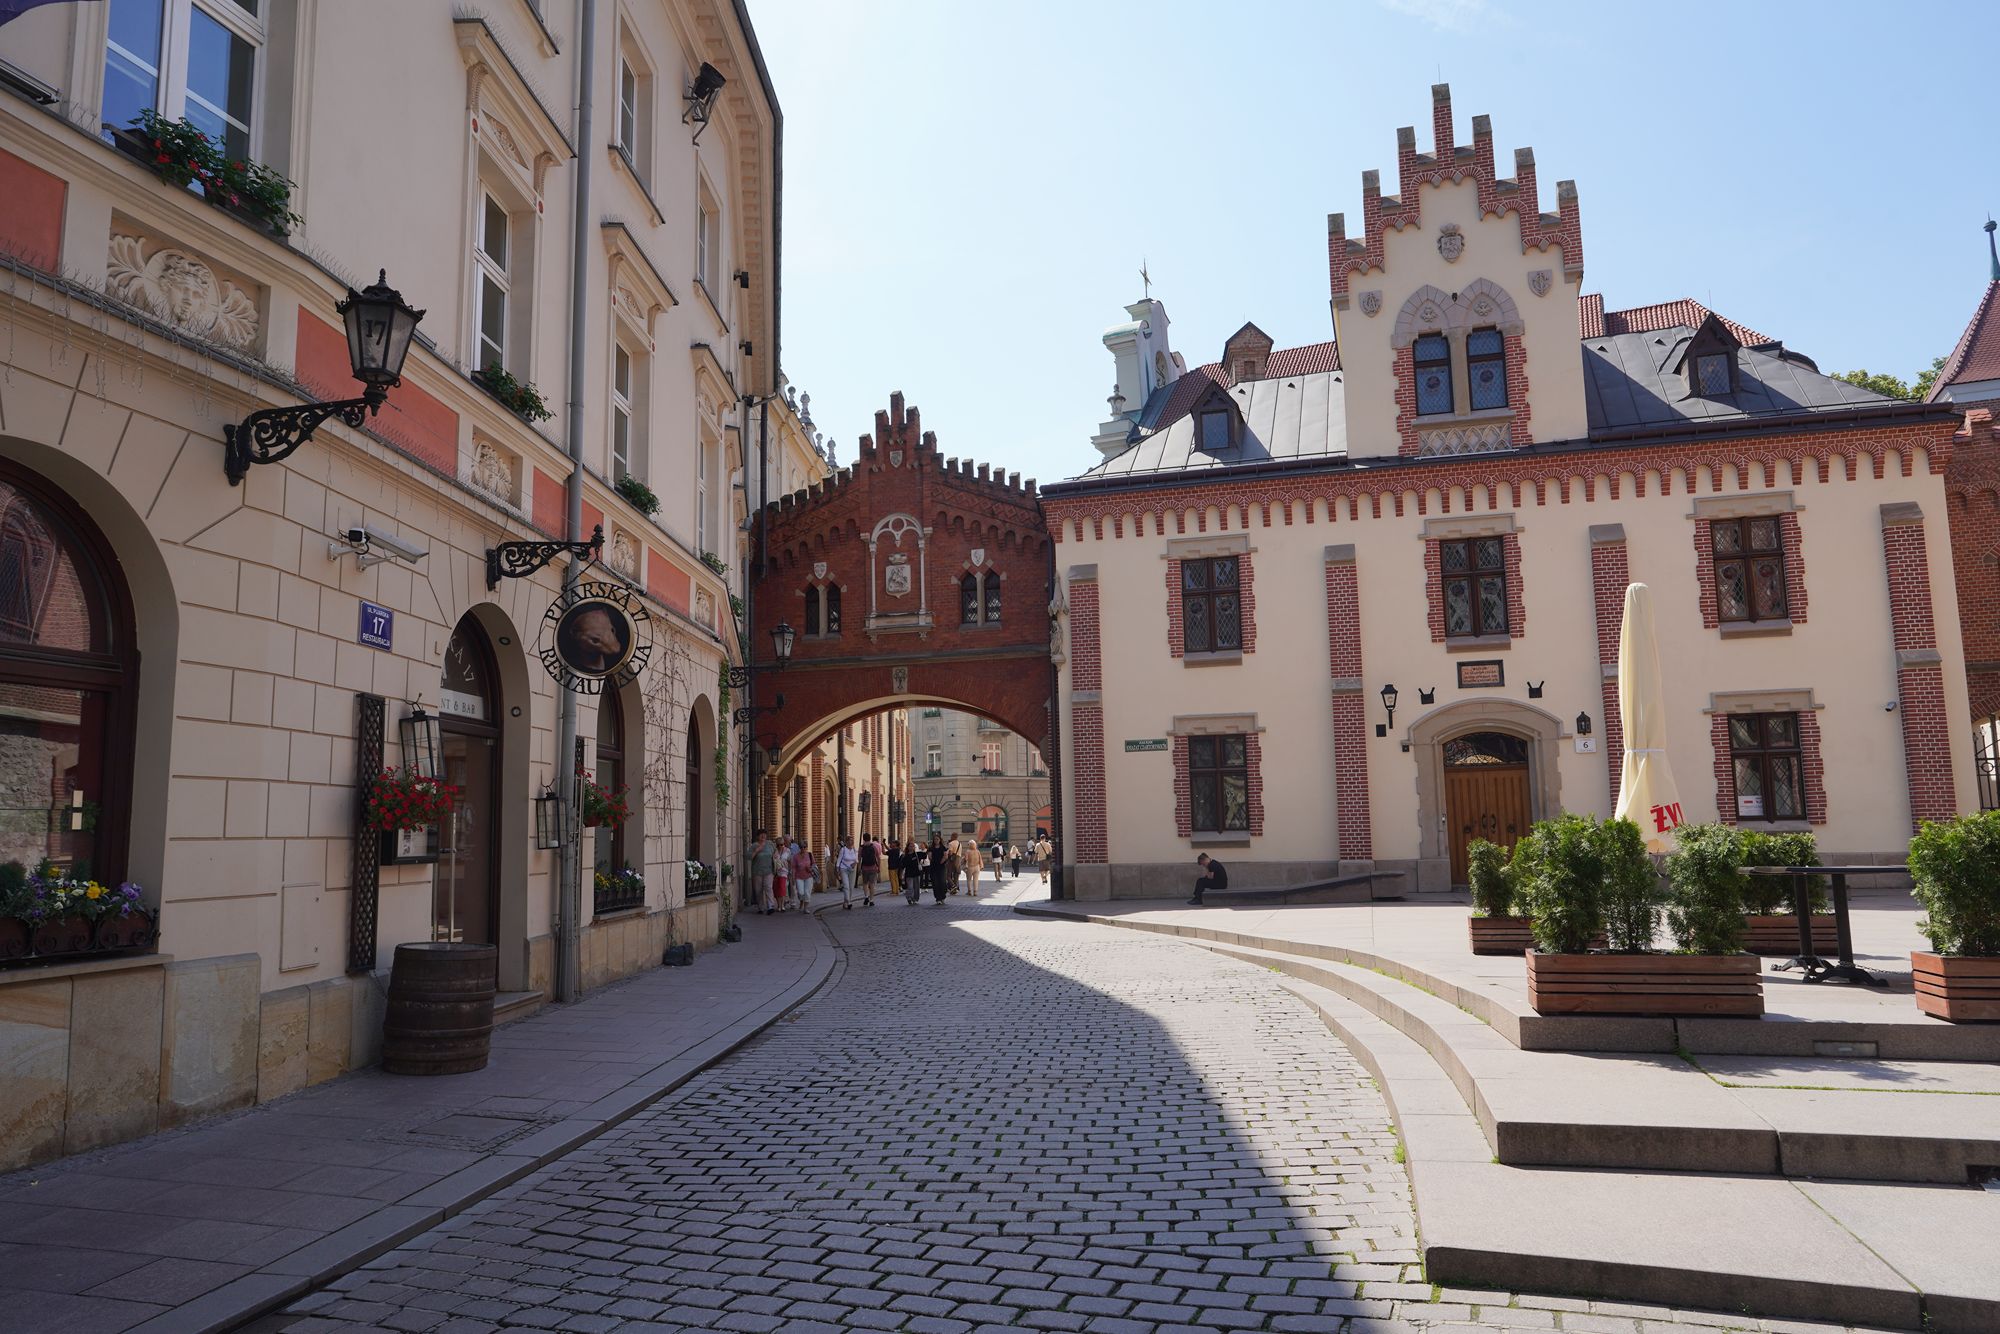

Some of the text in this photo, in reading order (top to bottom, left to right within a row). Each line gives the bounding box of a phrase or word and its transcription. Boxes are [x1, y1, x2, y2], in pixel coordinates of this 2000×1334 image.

[365, 319, 387, 346] 17
[545, 582, 632, 623] PIJARSKA
[373, 616, 385, 636] 17
[540, 645, 652, 695] RESTAUACJA
[453, 700, 459, 712] &
[461, 702, 476, 715] BAR
[1583, 741, 1589, 749] 6
